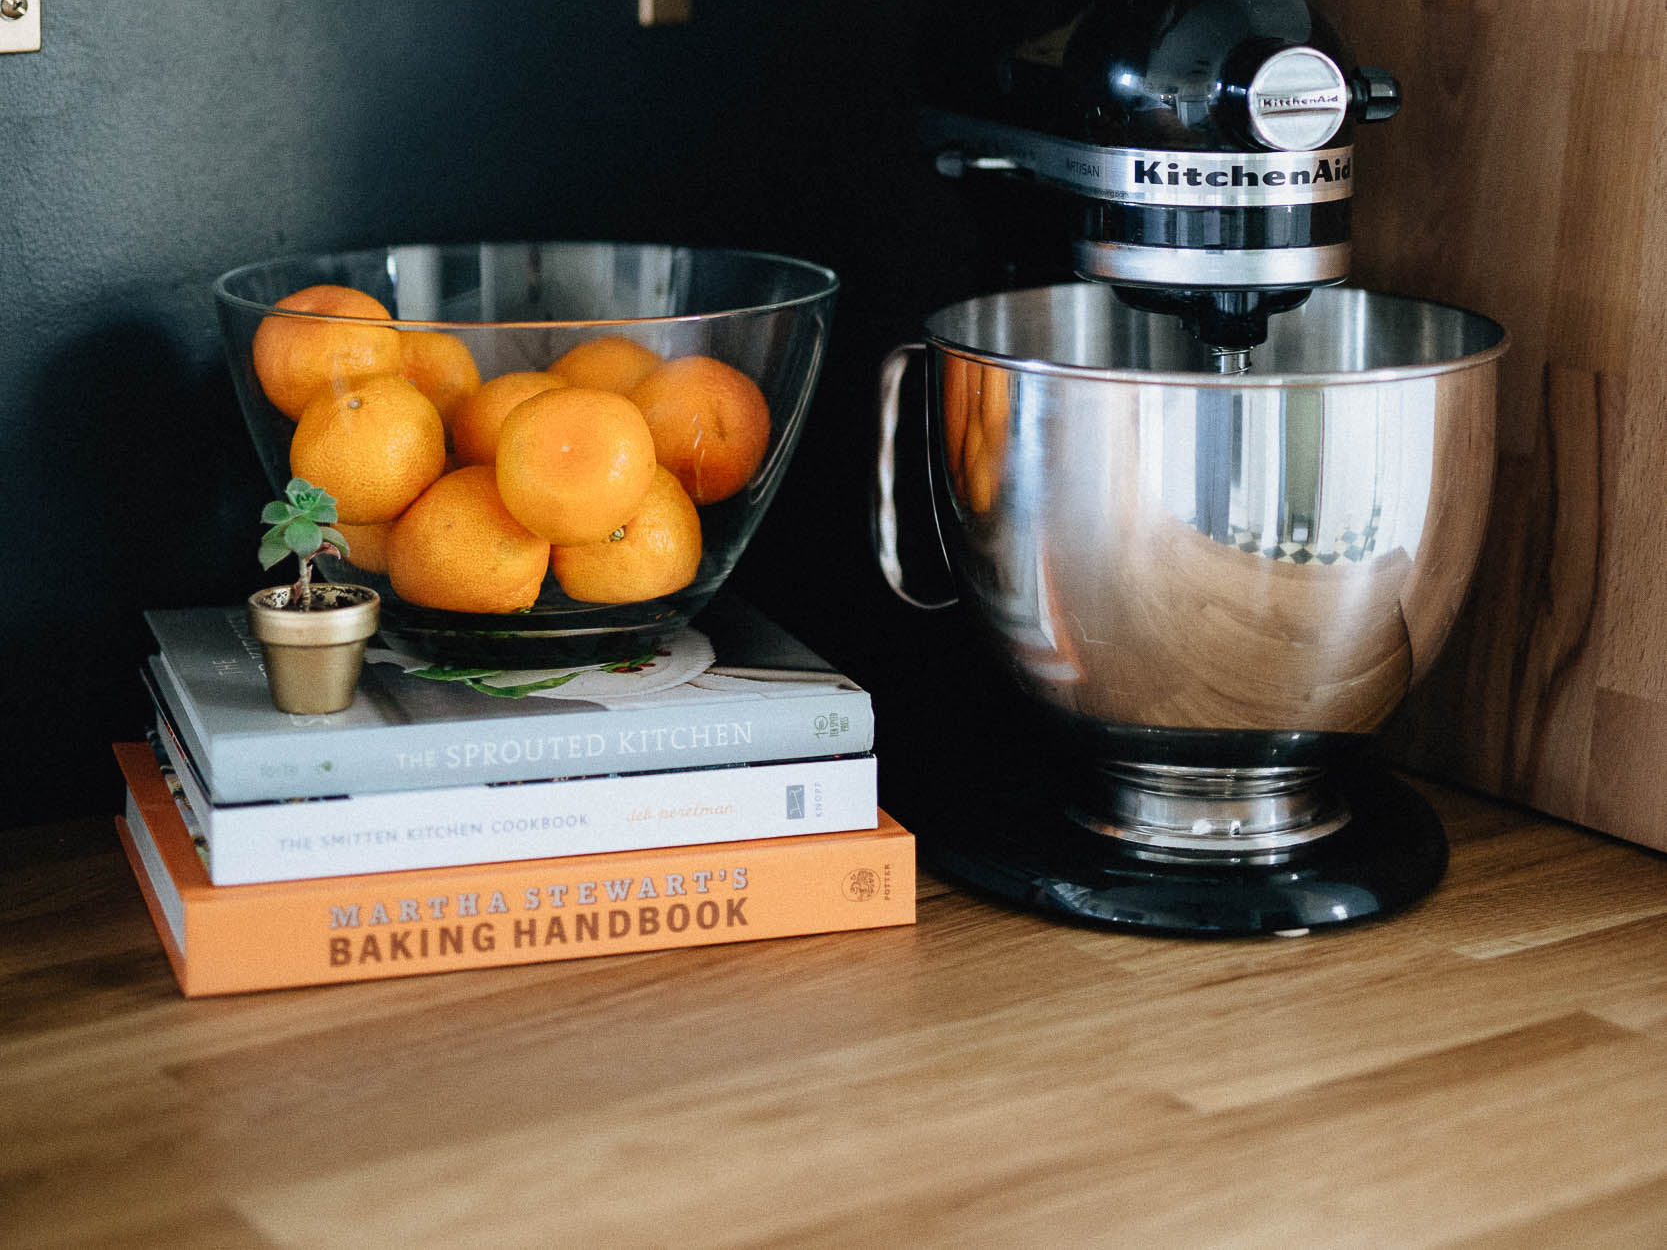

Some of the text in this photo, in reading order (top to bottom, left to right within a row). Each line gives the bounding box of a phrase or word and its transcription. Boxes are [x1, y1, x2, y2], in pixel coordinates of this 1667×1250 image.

[1263, 95, 1338, 108] KitchenAid
[1134, 158, 1351, 187] KitchenAid
[396, 721, 753, 770] THE SPROUTED KITCHEN
[279, 813, 589, 851] THE SMITTEN KITCHEN COOKBOOK
[329, 867, 750, 929] MARTHA STEWART'S
[329, 896, 750, 968] BAKING HANDBOOK
